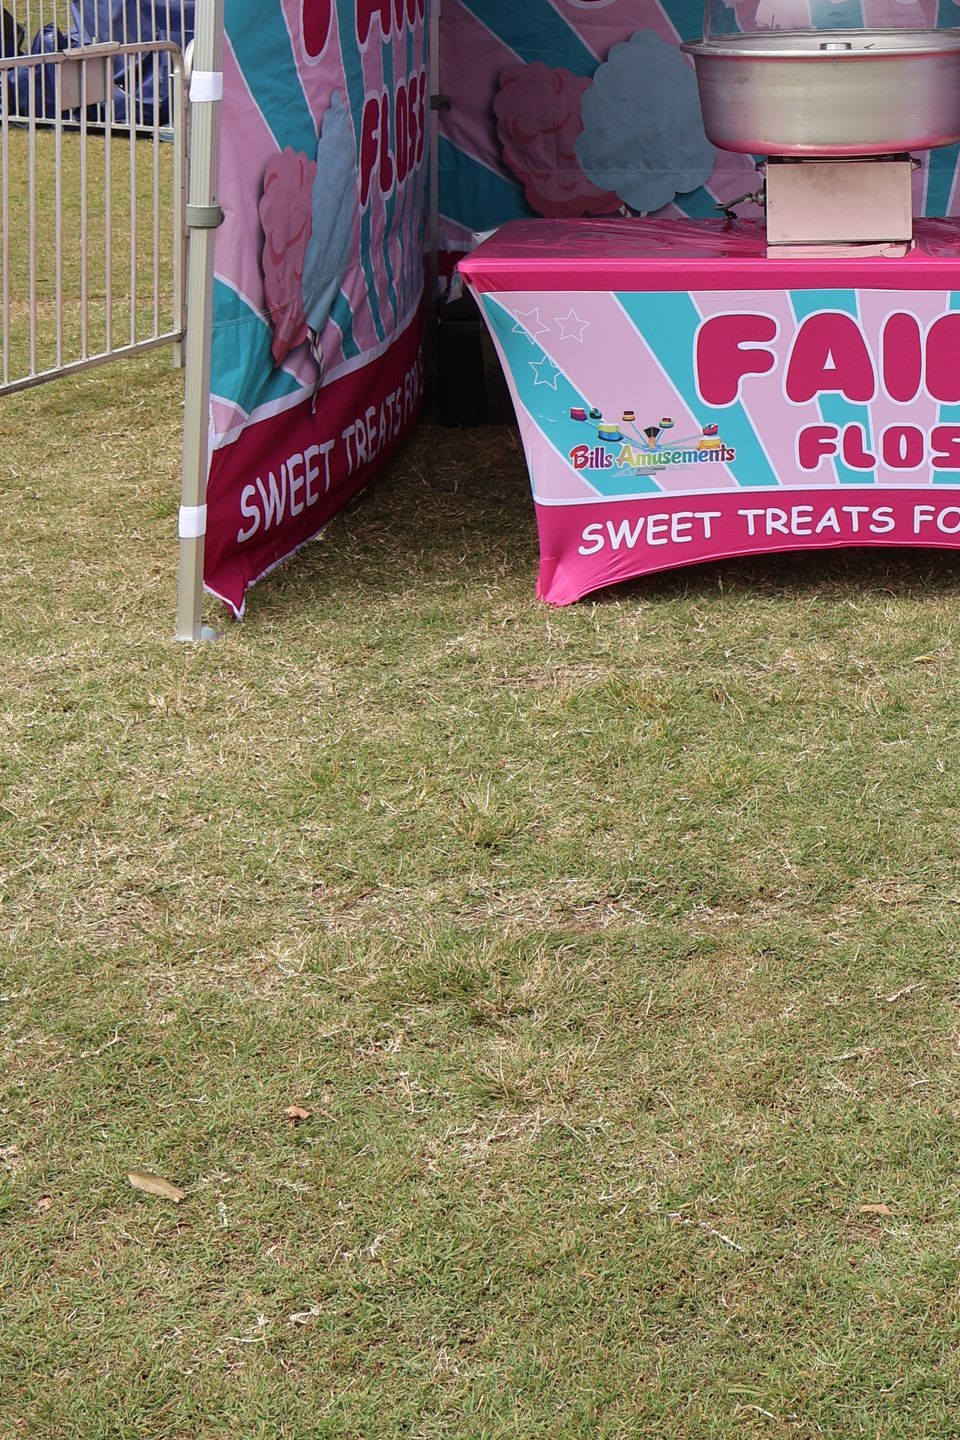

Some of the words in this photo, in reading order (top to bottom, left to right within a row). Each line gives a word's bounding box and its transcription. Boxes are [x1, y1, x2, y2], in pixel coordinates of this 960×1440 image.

[357, 68, 427, 212] FLOSS
[237, 438, 335, 544] SWEET
[341, 386, 402, 478] TREATS
[569, 444, 614, 470] Bills
[616, 444, 736, 469] Amusements
[578, 511, 721, 557] SWEET
[737, 505, 896, 535] TREATS
